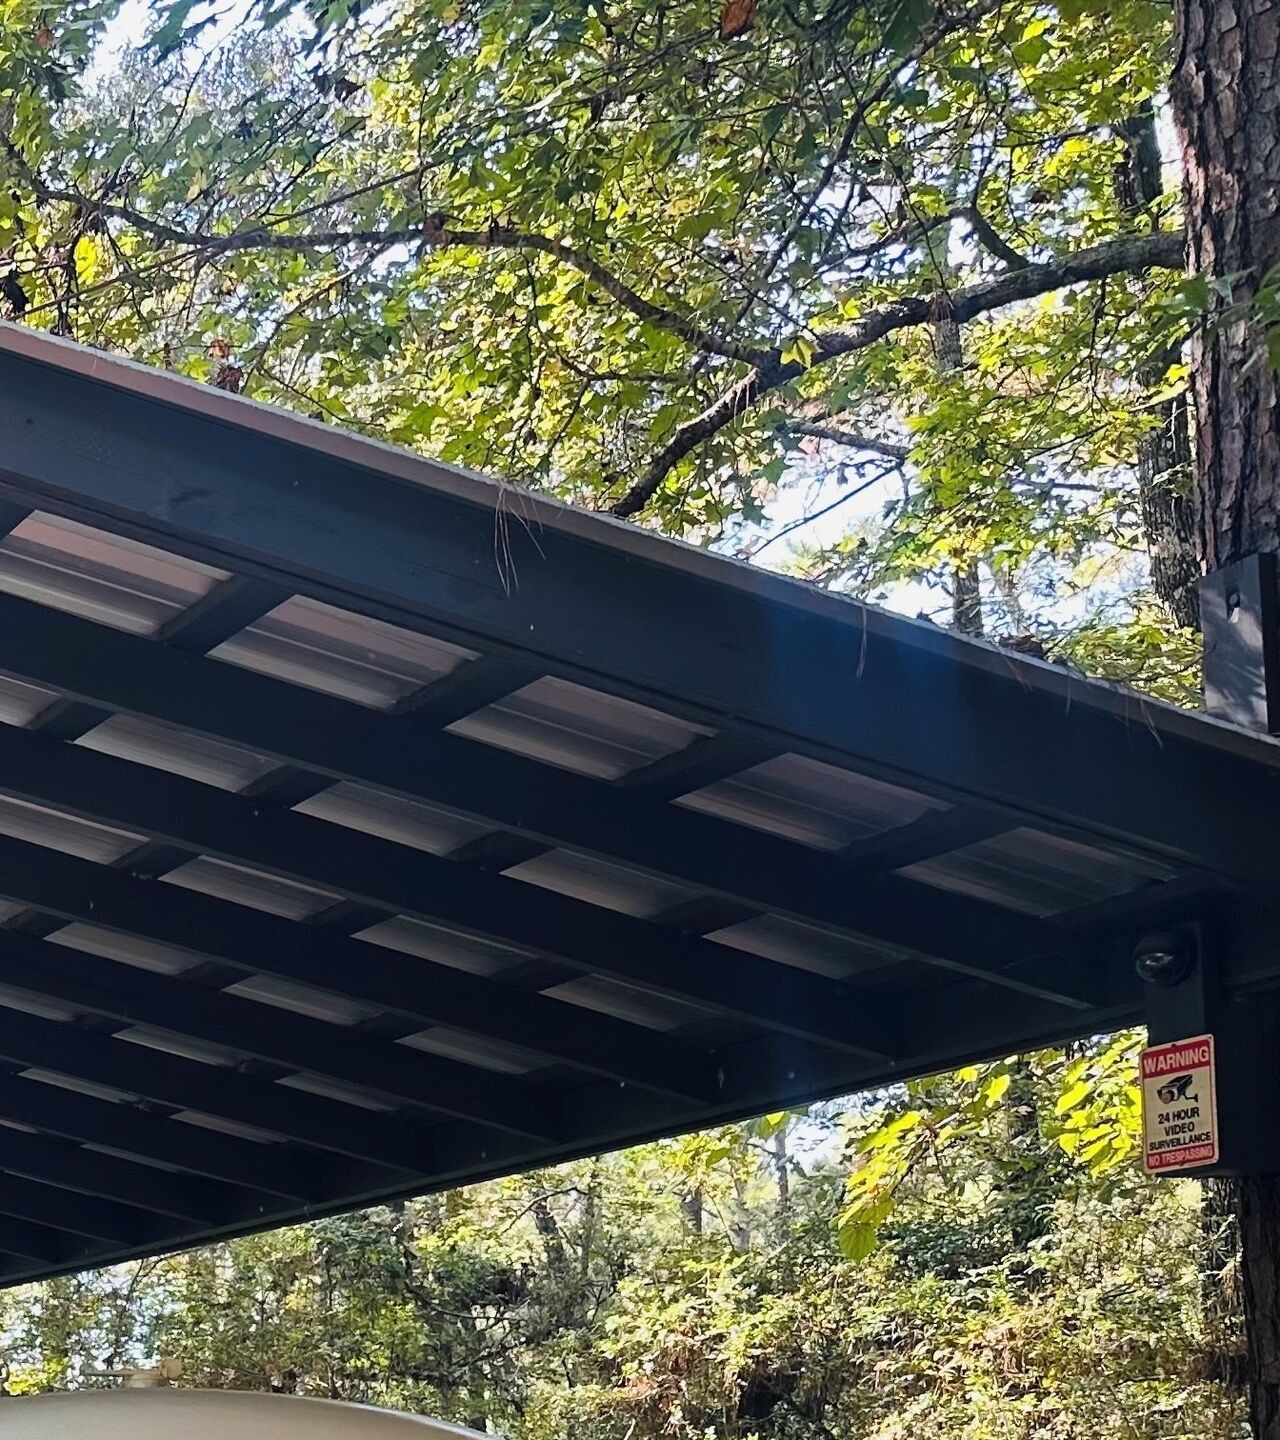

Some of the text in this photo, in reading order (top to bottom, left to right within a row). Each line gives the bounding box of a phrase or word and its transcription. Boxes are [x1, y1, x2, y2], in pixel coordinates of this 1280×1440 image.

[1143, 1046, 1210, 1074] WARNING
[1158, 1106, 1200, 1124] 24 HOUR
[1164, 1121, 1195, 1136] VIDEO
[1149, 1131, 1211, 1151] SURVEILLANCE
[1148, 1144, 1213, 1167] NO TRESPASSING
